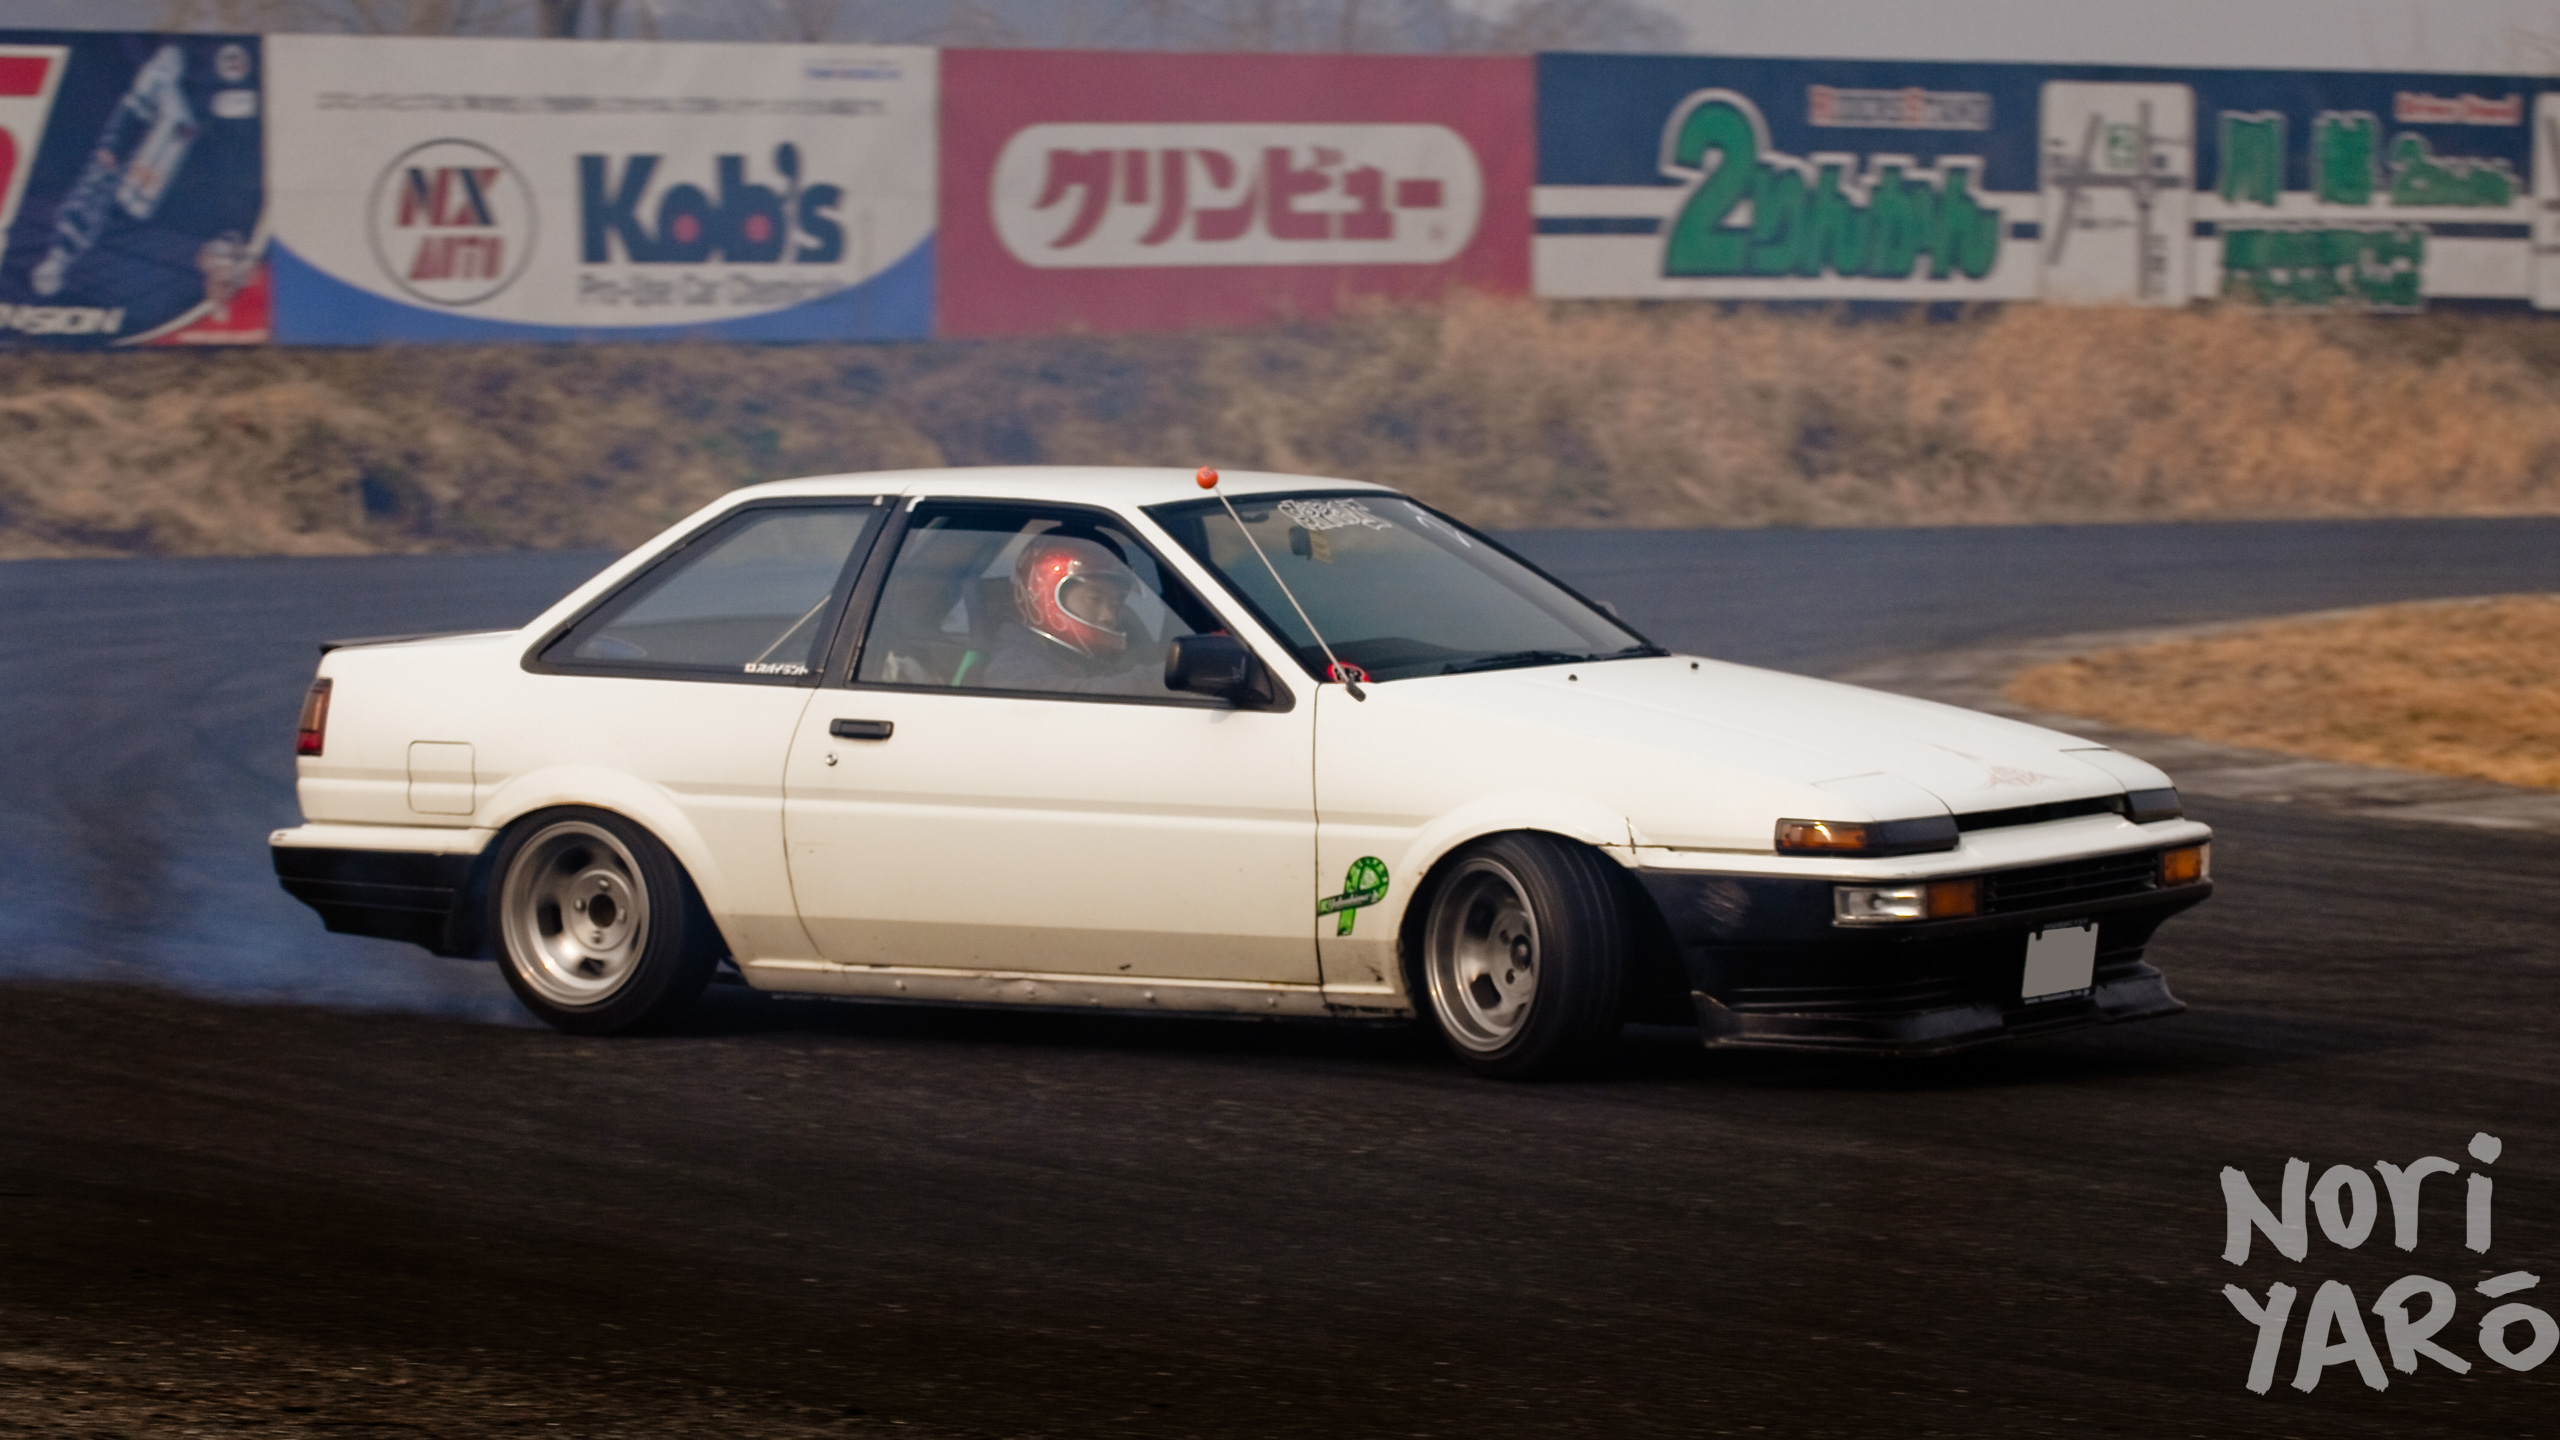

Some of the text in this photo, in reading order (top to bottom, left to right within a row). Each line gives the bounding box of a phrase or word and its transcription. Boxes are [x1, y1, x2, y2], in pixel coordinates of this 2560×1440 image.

[576, 141, 846, 265] Kob's
[1028, 145, 1446, 250] クリンビュー
